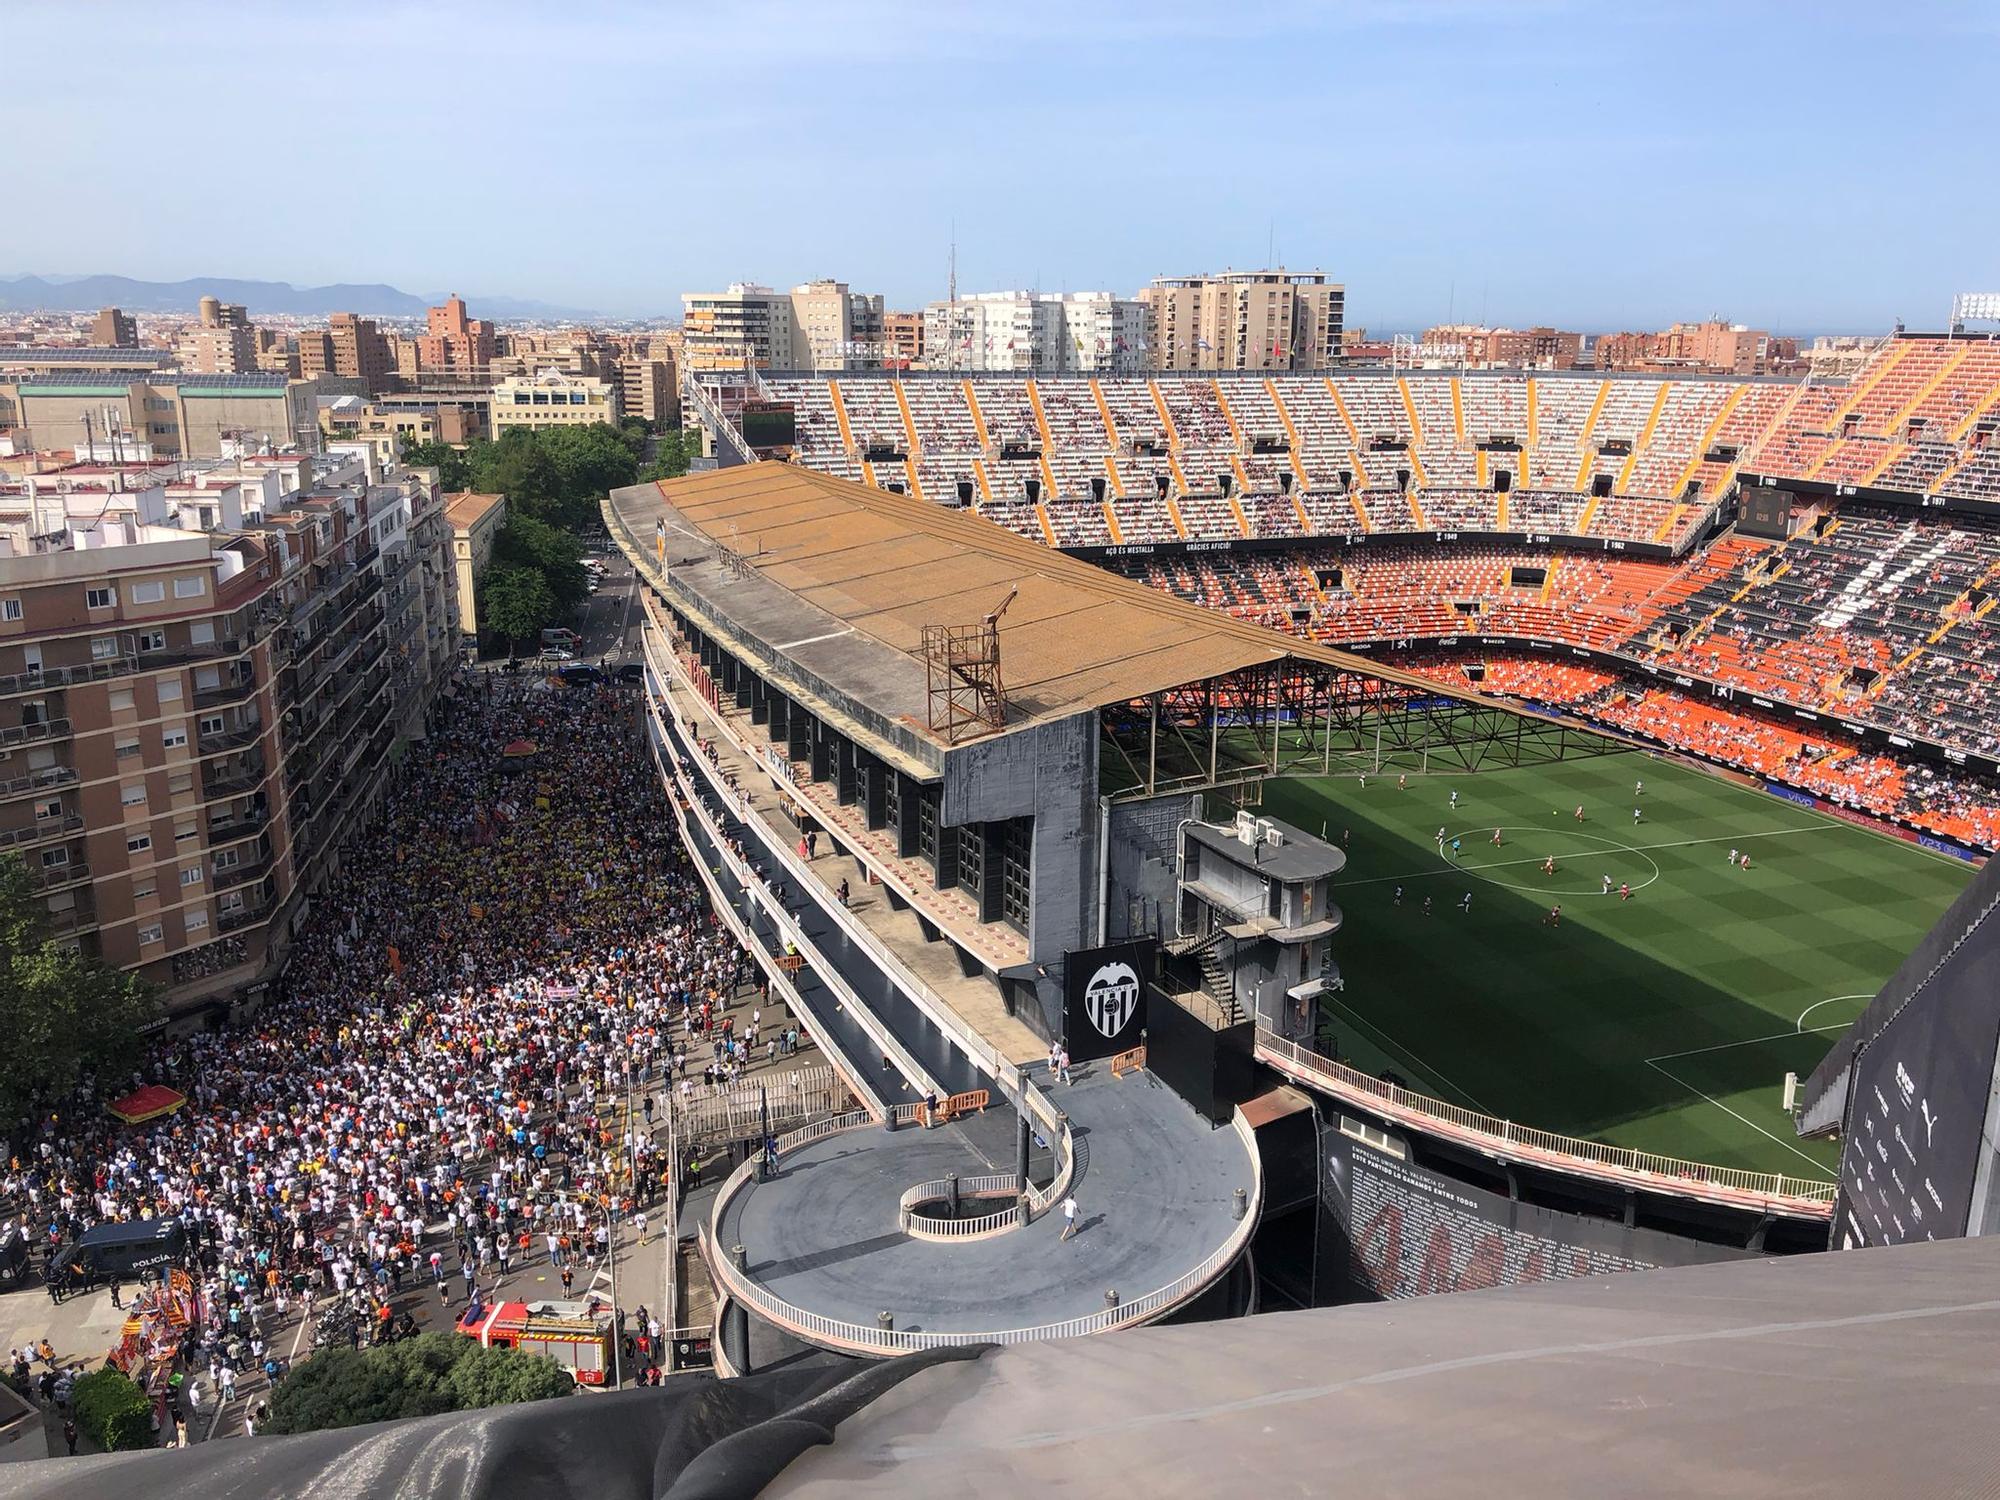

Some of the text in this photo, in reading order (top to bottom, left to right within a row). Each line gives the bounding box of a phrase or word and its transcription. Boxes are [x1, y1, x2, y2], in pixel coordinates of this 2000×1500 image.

[1128, 546, 1154, 554] MESTALLA
[1186, 542, 1210, 551] GRÀCIES
[1788, 792, 1812, 808] vivo
[1864, 817, 1904, 838] Santander
[1090, 986, 1122, 996] VALENCIA
[1352, 1146, 1380, 1162] EMPRESAS
[1380, 1158, 1400, 1172] UNIDAS
[1410, 1171, 1436, 1186] VALENCIA
[1352, 1152, 1478, 1208] ESTE PARTIDO LO GANAMOS ENTRE TODOS
[132, 1254, 170, 1268] POLICÍA
